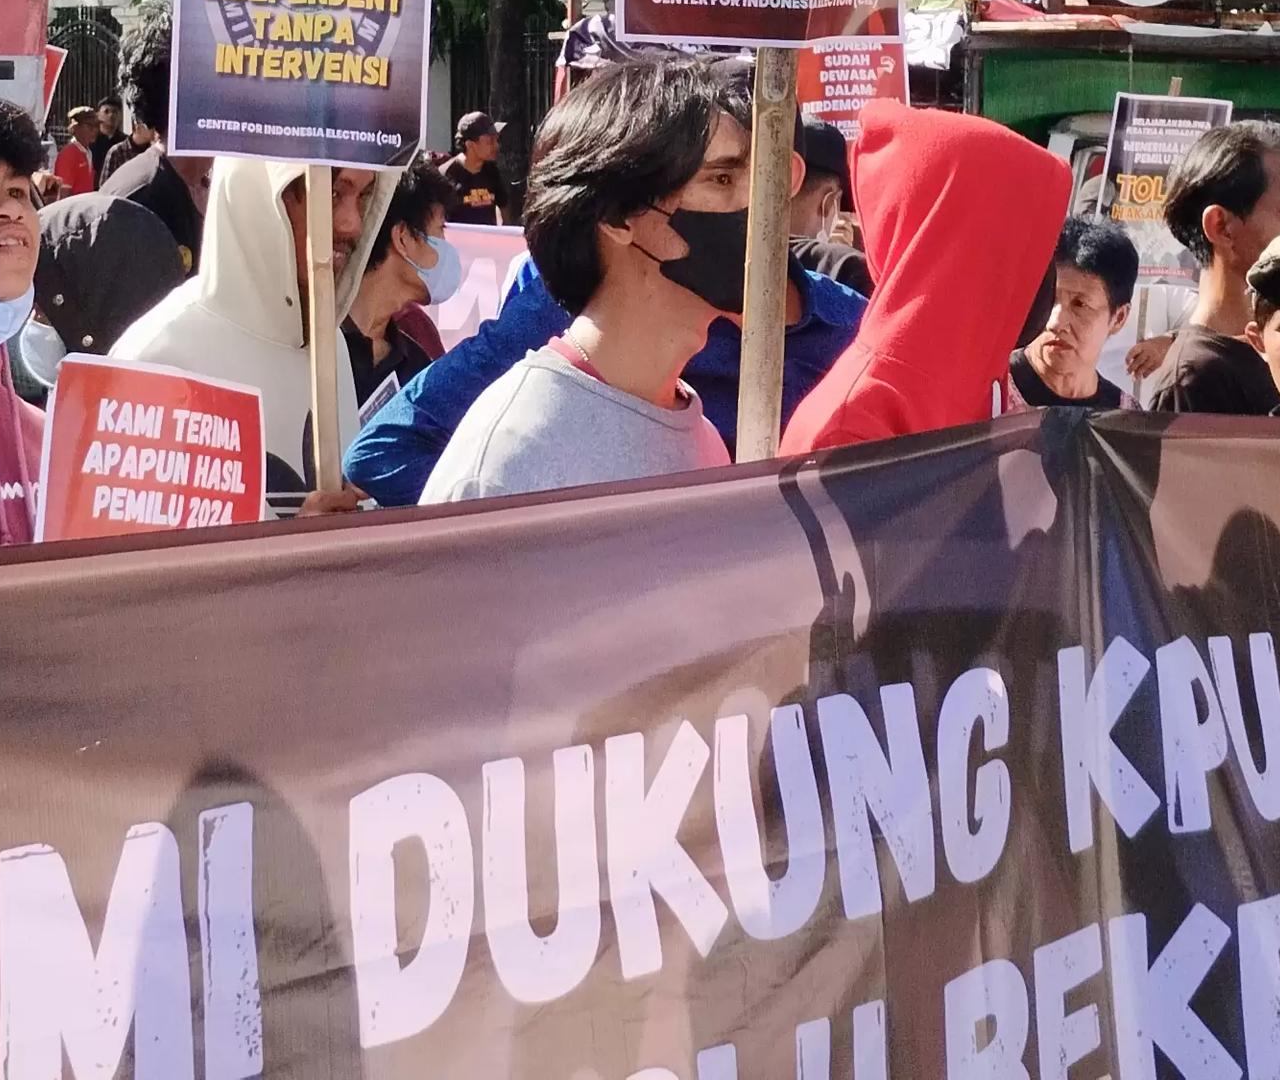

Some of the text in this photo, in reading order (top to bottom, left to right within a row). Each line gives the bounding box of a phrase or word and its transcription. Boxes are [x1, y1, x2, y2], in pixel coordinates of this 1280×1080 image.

[252, 11, 355, 46] TANPA
[215, 44, 389, 87] INTERVENSI
[820, 69, 878, 83] DEWASA
[824, 55, 870, 67] SUDAH
[825, 84, 874, 97] DALAM
[197, 118, 241, 132] CENTER
[241, 121, 263, 134] FOR
[264, 124, 324, 138] INDONESIA
[326, 128, 376, 142] ELECTION
[1116, 174, 1168, 204] TOL
[97, 398, 241, 452] KAMI TERIMA
[81, 441, 246, 494] APAPUN HASIL
[92, 486, 233, 529] PEMILU 2024
[347, 666, 1013, 1050] DUKUNG
